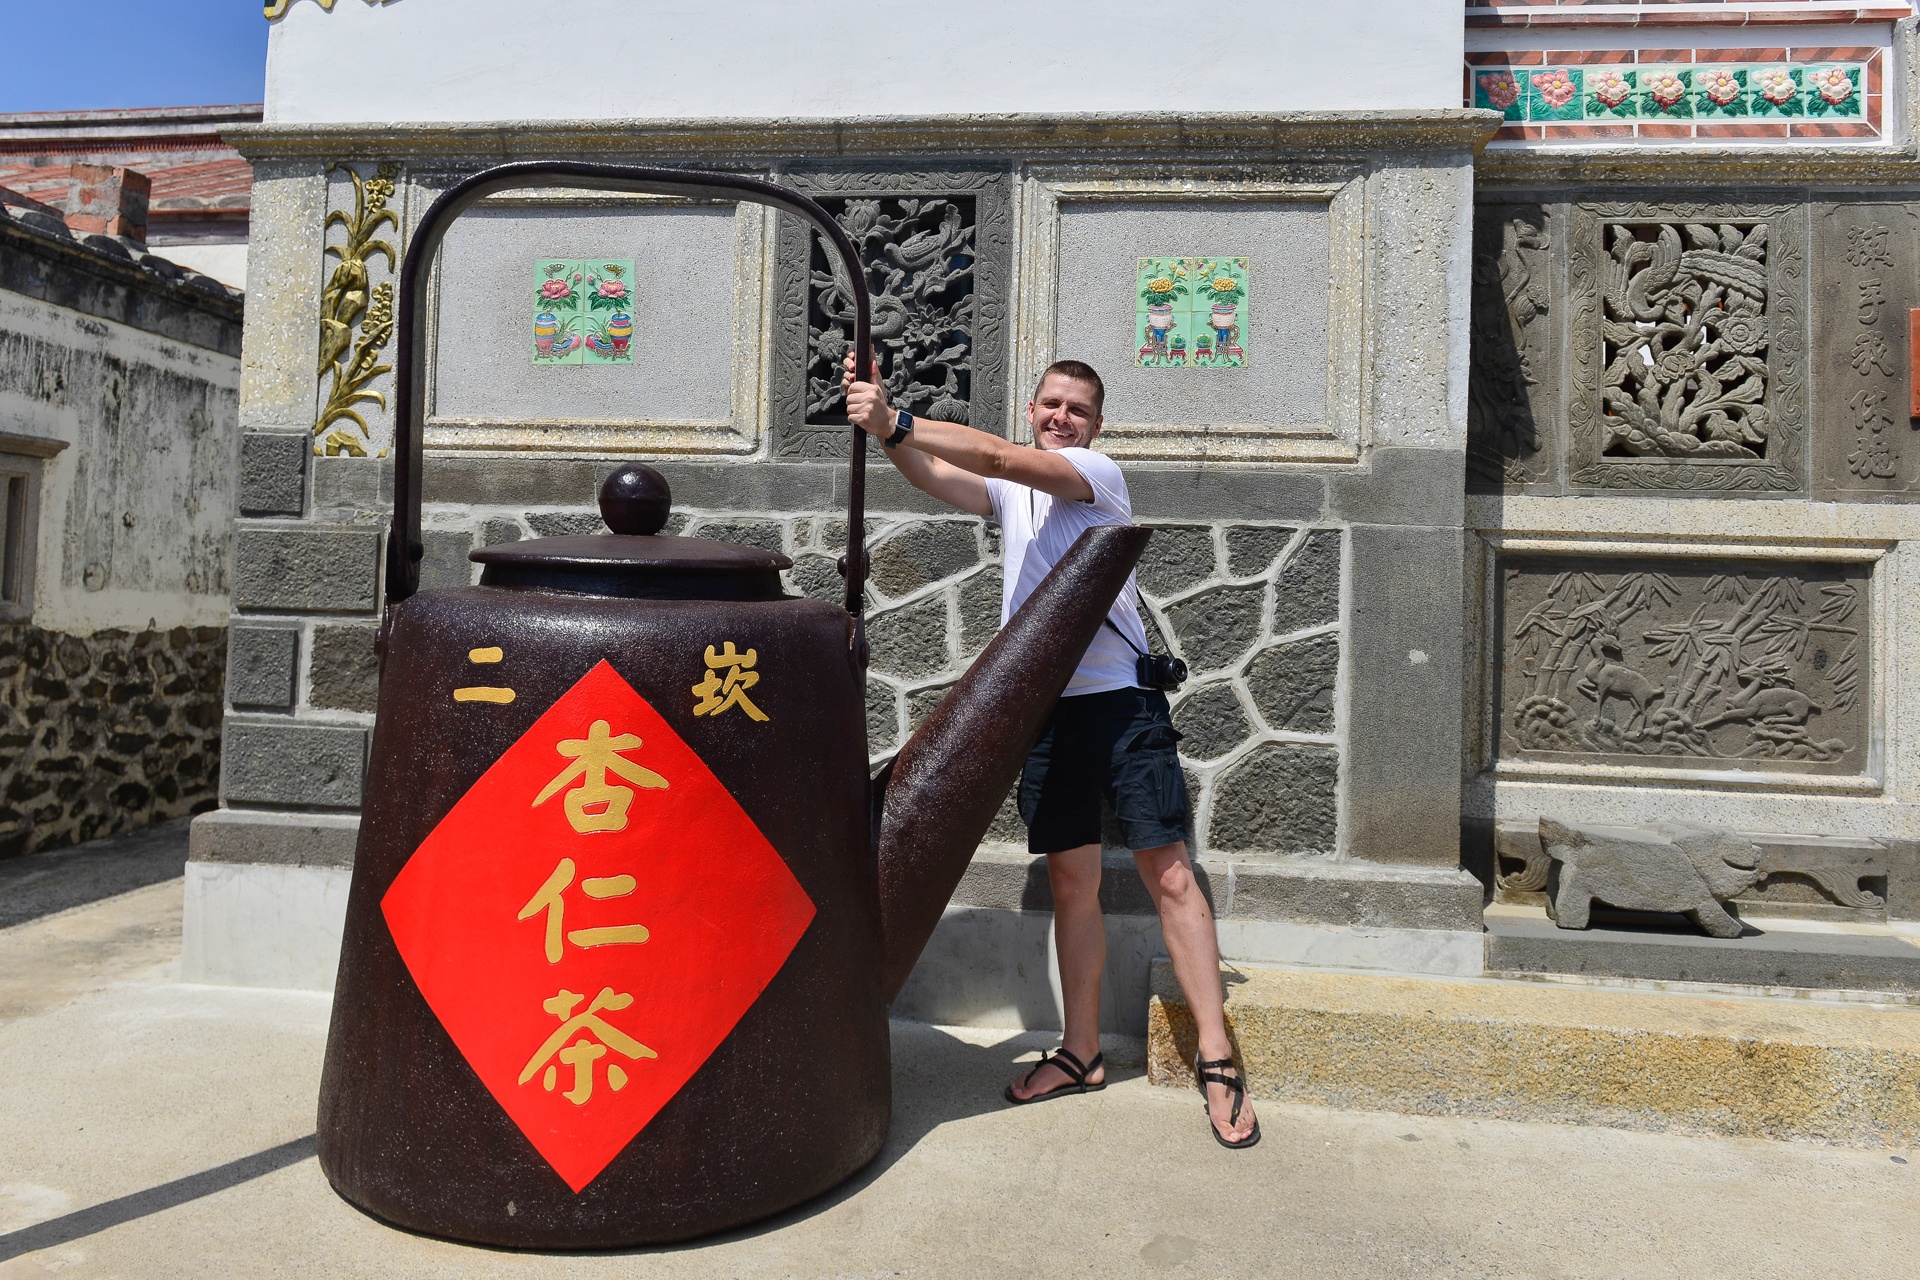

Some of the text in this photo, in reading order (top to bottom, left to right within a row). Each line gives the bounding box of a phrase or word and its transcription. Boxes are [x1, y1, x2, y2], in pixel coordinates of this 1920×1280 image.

[453, 641, 769, 721] 二 崁
[517, 719, 669, 1106] 杏仁茶
